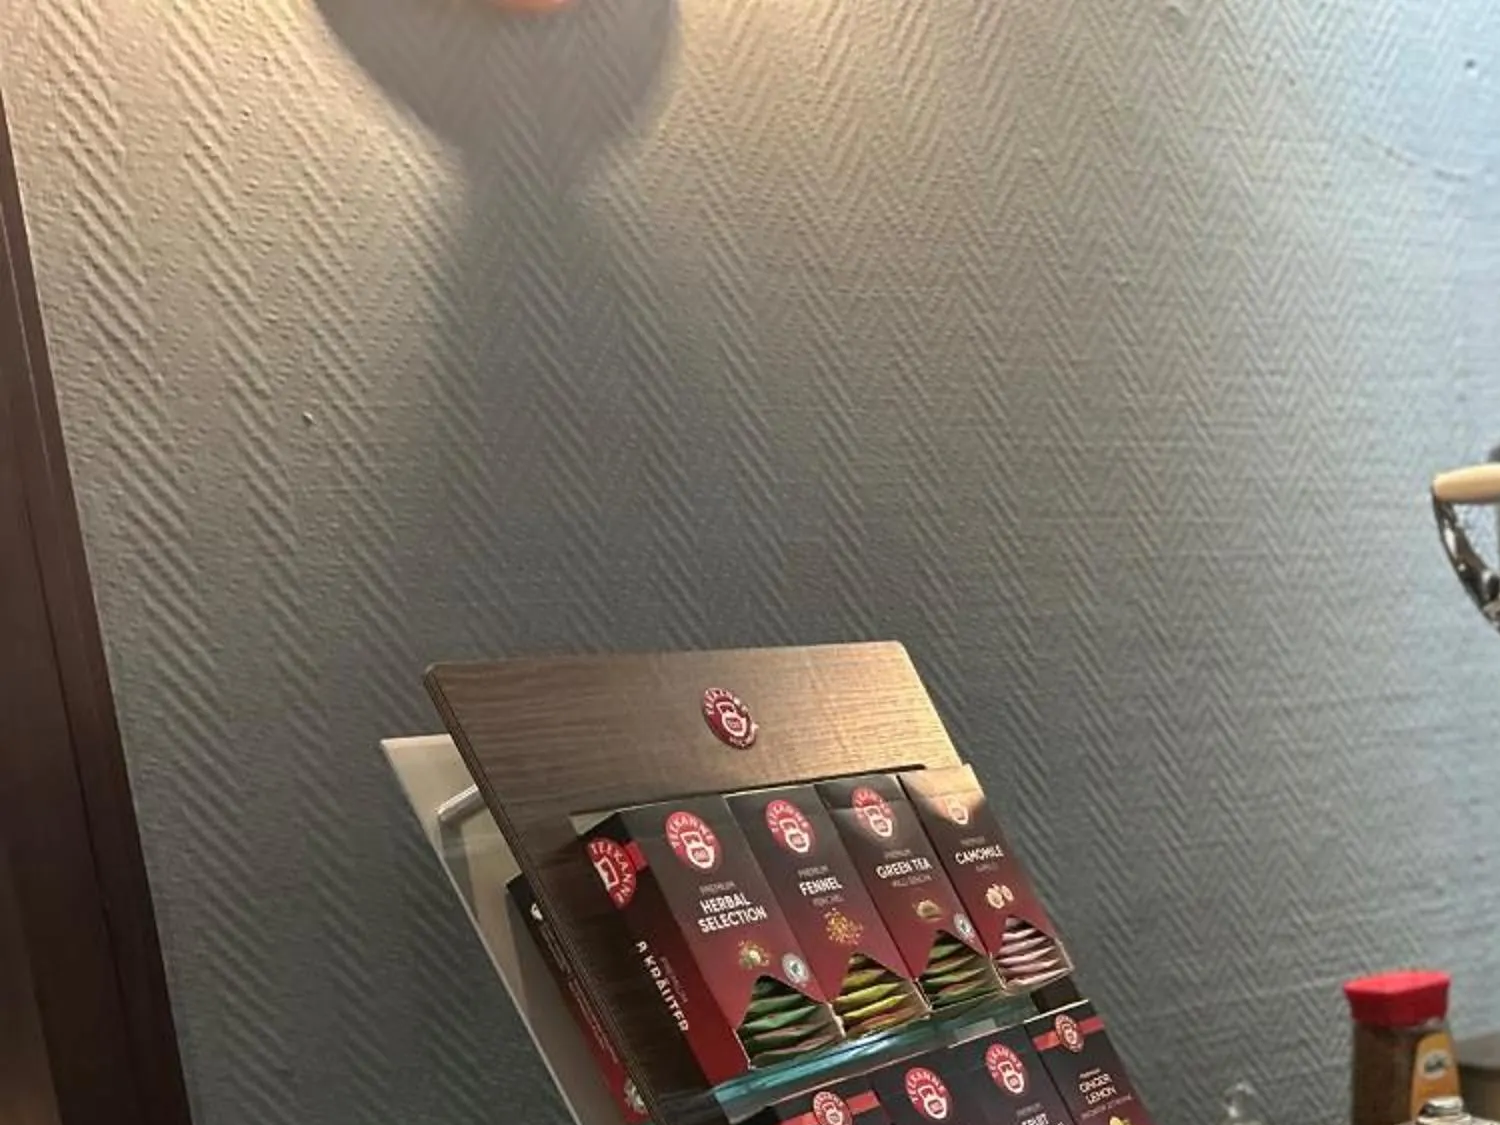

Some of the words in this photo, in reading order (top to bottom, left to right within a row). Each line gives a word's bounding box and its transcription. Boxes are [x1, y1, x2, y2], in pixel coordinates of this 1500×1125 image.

[955, 844, 1004, 865] CAMOMILE
[875, 862, 912, 880] GREEN
[912, 856, 934, 872] TEA
[799, 876, 843, 897] FENNEL
[700, 892, 751, 914] HERBAL
[698, 905, 768, 933] SELECTION
[1085, 1085, 1118, 1105] LEMON
